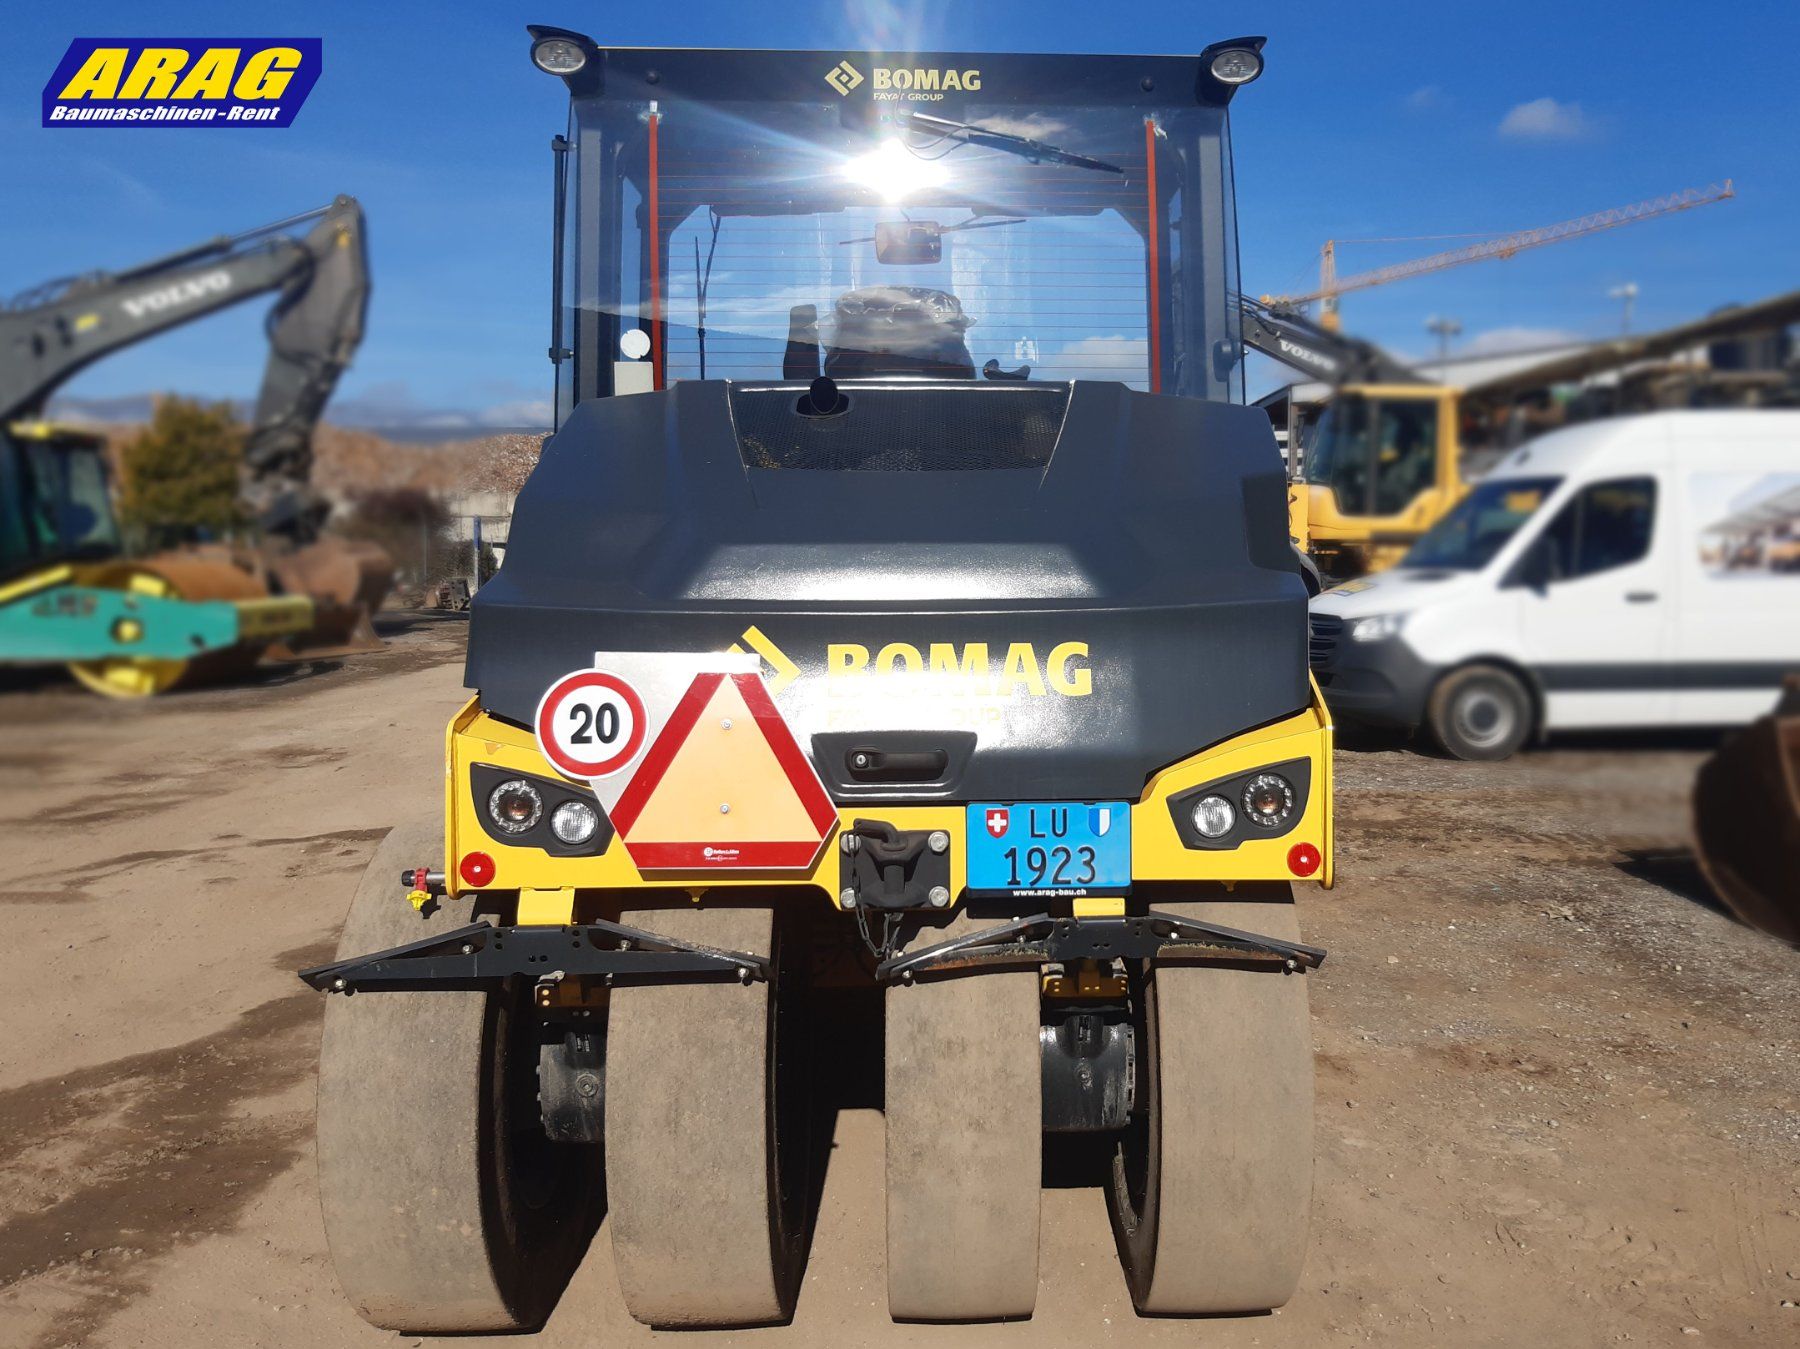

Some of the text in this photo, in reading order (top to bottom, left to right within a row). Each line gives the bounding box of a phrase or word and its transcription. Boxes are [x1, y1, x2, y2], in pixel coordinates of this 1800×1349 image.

[873, 68, 982, 91] BOMAG
[907, 93, 945, 101] GROUP
[121, 270, 232, 317] VOLVO
[569, 702, 620, 744] 20
[1030, 808, 1068, 838] LU
[1004, 846, 1096, 887] 1923
[1012, 888, 1087, 897] www.arag-bau.ch
